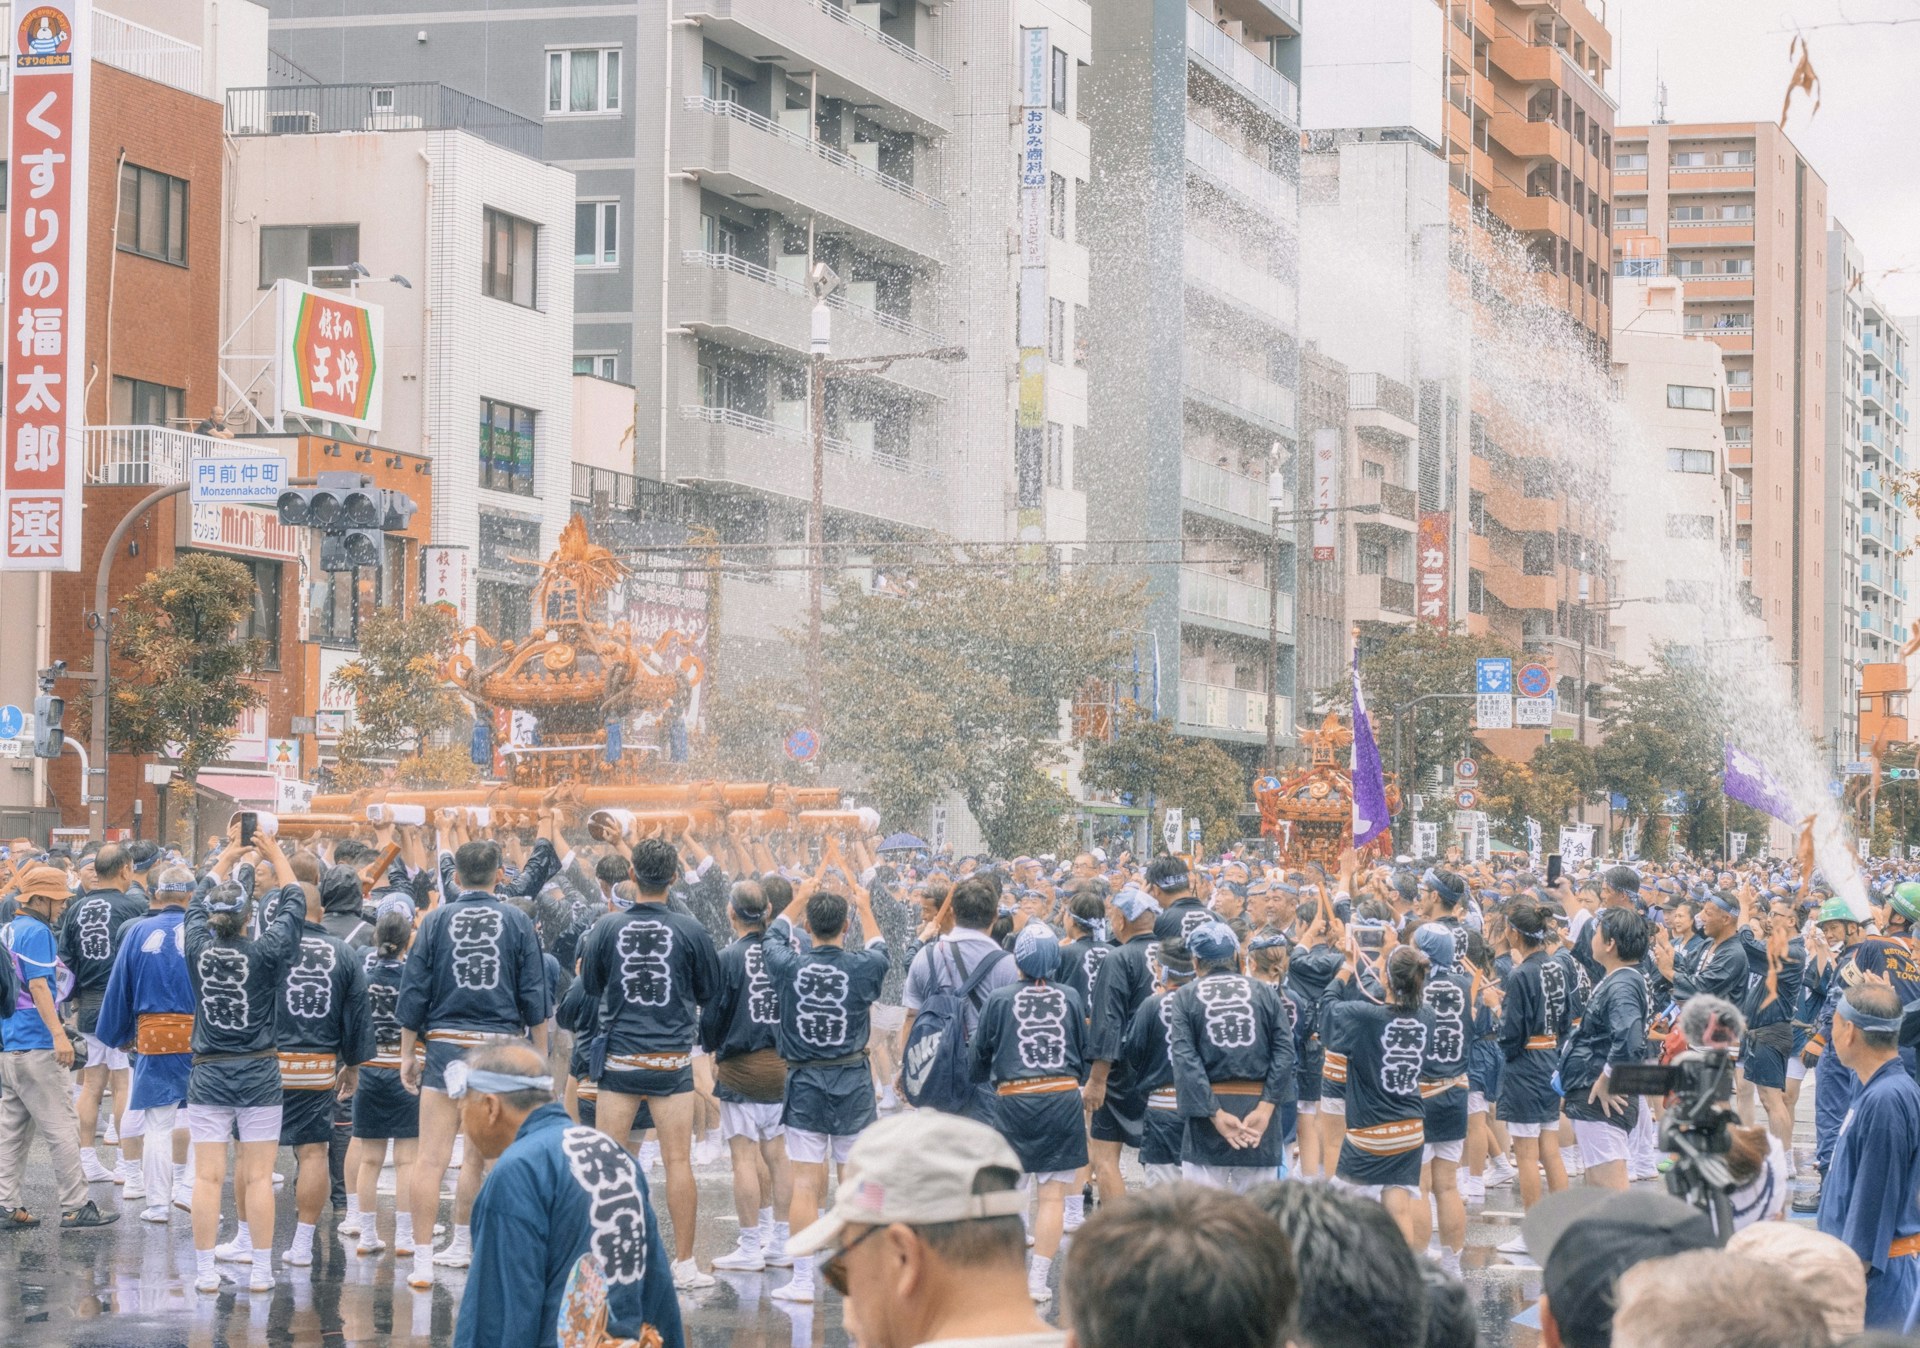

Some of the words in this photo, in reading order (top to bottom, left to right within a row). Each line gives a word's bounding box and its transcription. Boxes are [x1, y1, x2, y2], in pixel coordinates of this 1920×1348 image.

[17, 55, 70, 66] くすりの福太郎
[1026, 110, 1043, 174] おおみ歯科
[14, 91, 66, 473] くすりの福太郎
[318, 306, 354, 341] 餃子の
[310, 343, 359, 405] 王将
[199, 464, 280, 484] 門前仲町
[200, 485, 278, 497] Monzennakacho
[11, 501, 61, 554] 薬
[193, 522, 221, 541] マンション
[194, 503, 221, 522] アパート
[221, 506, 254, 547] mini
[436, 550, 451, 598] 餃子の
[1422, 548, 1444, 616] カラオ
[448, 906, 504, 990] 永二南
[615, 920, 674, 1008] 永二南
[1896, 971, 1920, 982] TOKY
[793, 963, 849, 1047] 永二南
[1012, 985, 1068, 1069] 永二南
[1196, 974, 1256, 1048] 永二南
[908, 1031, 943, 1076] NIKE
